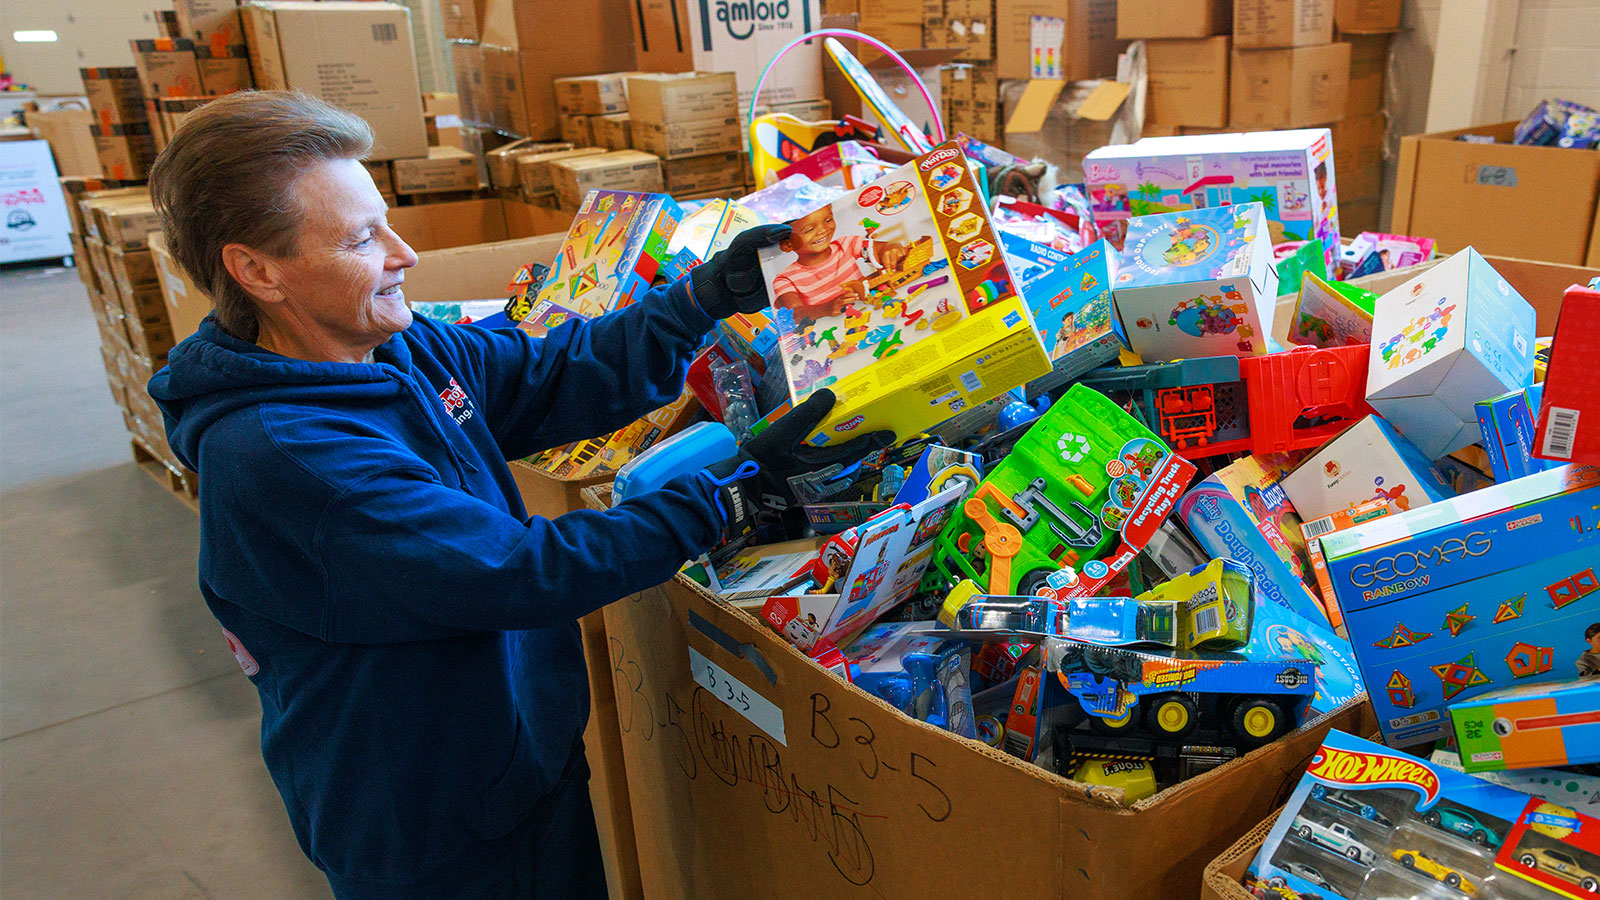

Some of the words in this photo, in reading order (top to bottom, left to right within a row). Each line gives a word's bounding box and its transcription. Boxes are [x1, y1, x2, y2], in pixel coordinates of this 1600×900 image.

[716, 0, 789, 39] amloid
[1030, 243, 1048, 258] RADIO
[640, 437, 651, 450] TRY
[652, 427, 661, 438] ME
[1132, 485, 1167, 528] Recycling
[1159, 462, 1181, 487] Truck
[1153, 497, 1173, 517] Play
[1166, 482, 1181, 498] Set
[1216, 520, 1255, 565] Dough
[1087, 562, 1101, 574] 16
[1350, 531, 1492, 588] GEOMAG
[1362, 575, 1430, 602] RAINBOW
[706, 665, 717, 689] B
[724, 680, 751, 712] 3-5
[1275, 673, 1309, 684] DIE-CAST
[1463, 720, 1484, 729] PCS
[1465, 729, 1483, 739] 32
[810, 692, 841, 749] B
[848, 717, 952, 823] 3-5
